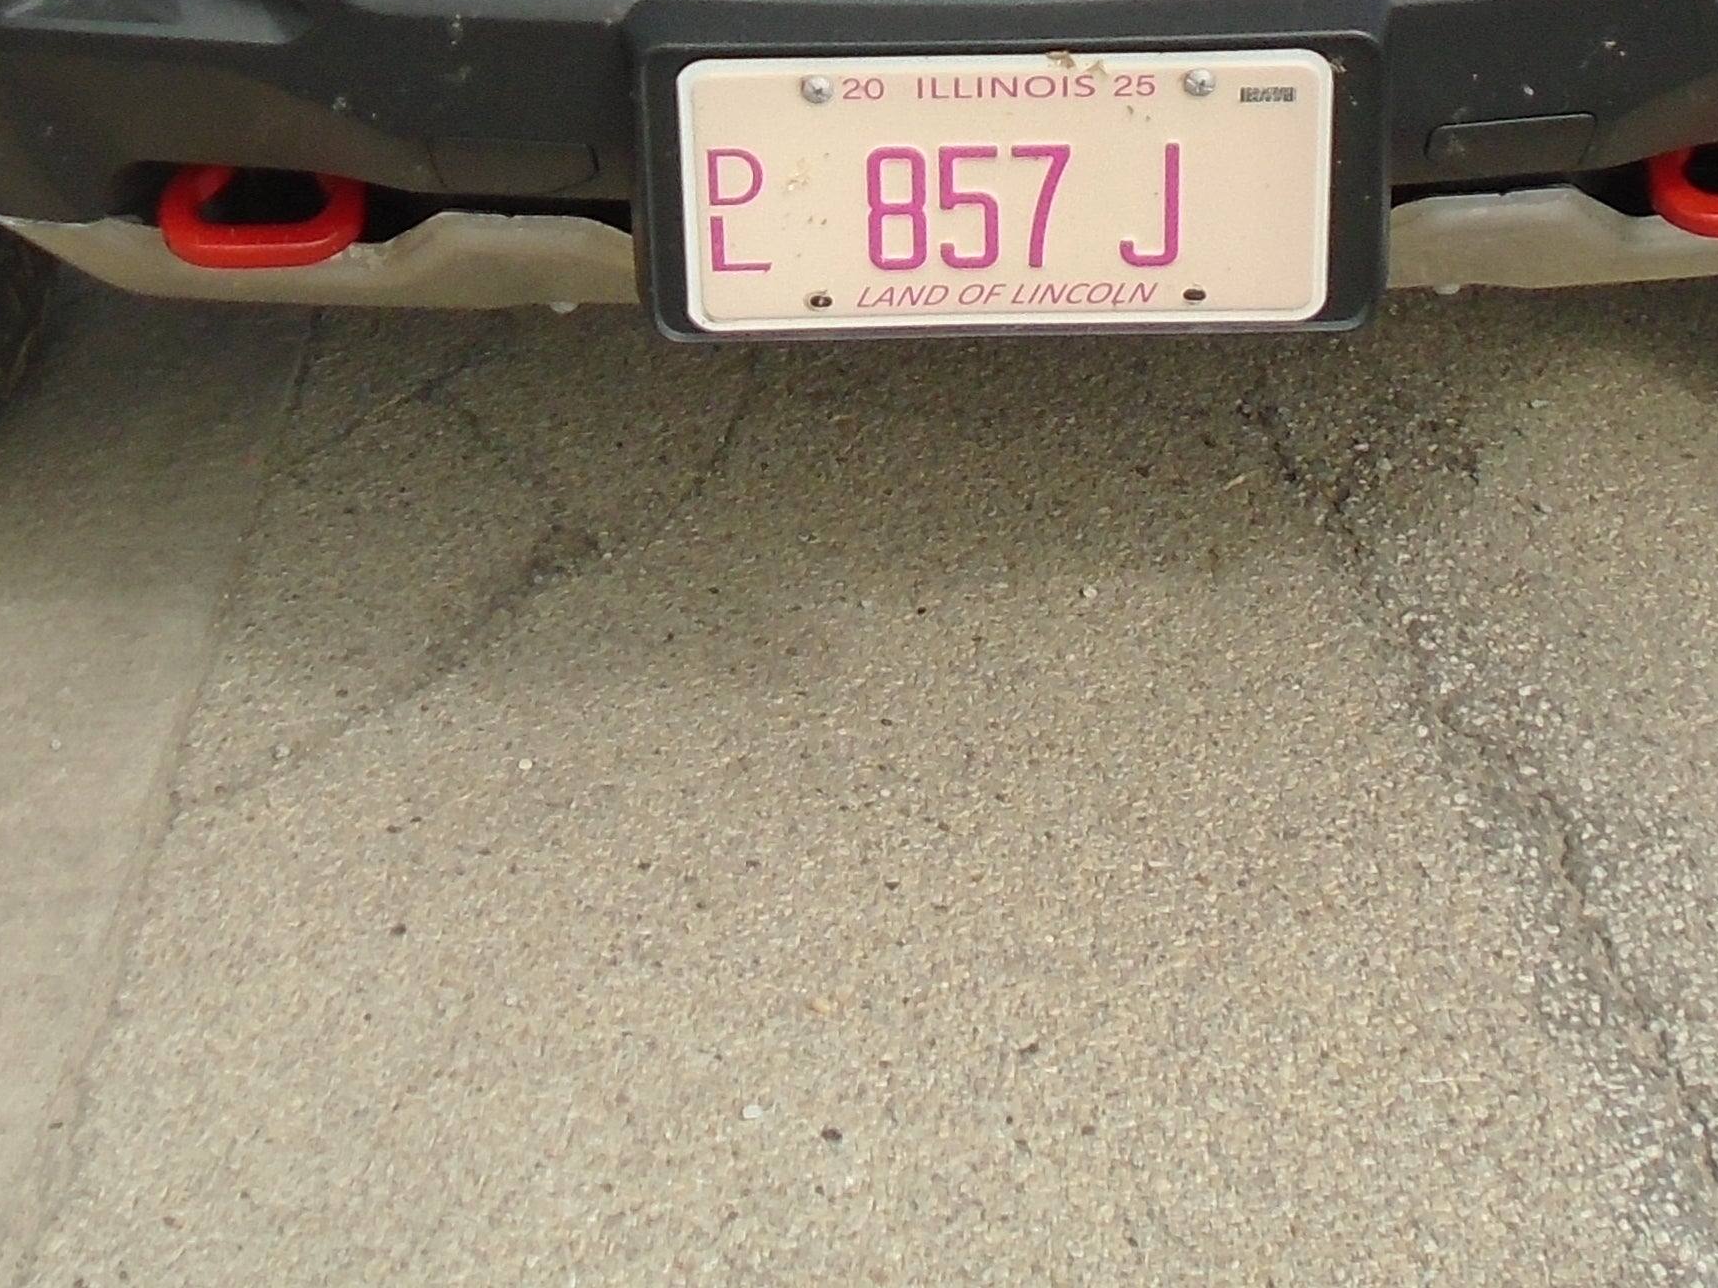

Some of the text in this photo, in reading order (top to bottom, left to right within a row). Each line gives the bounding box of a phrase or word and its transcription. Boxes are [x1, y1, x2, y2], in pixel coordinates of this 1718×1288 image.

[841, 74, 1157, 101] 20 ILLINOIS 25
[865, 144, 1071, 271] 857
[1118, 142, 1181, 267] J
[856, 281, 1159, 309] LAND OF LINCOLN
